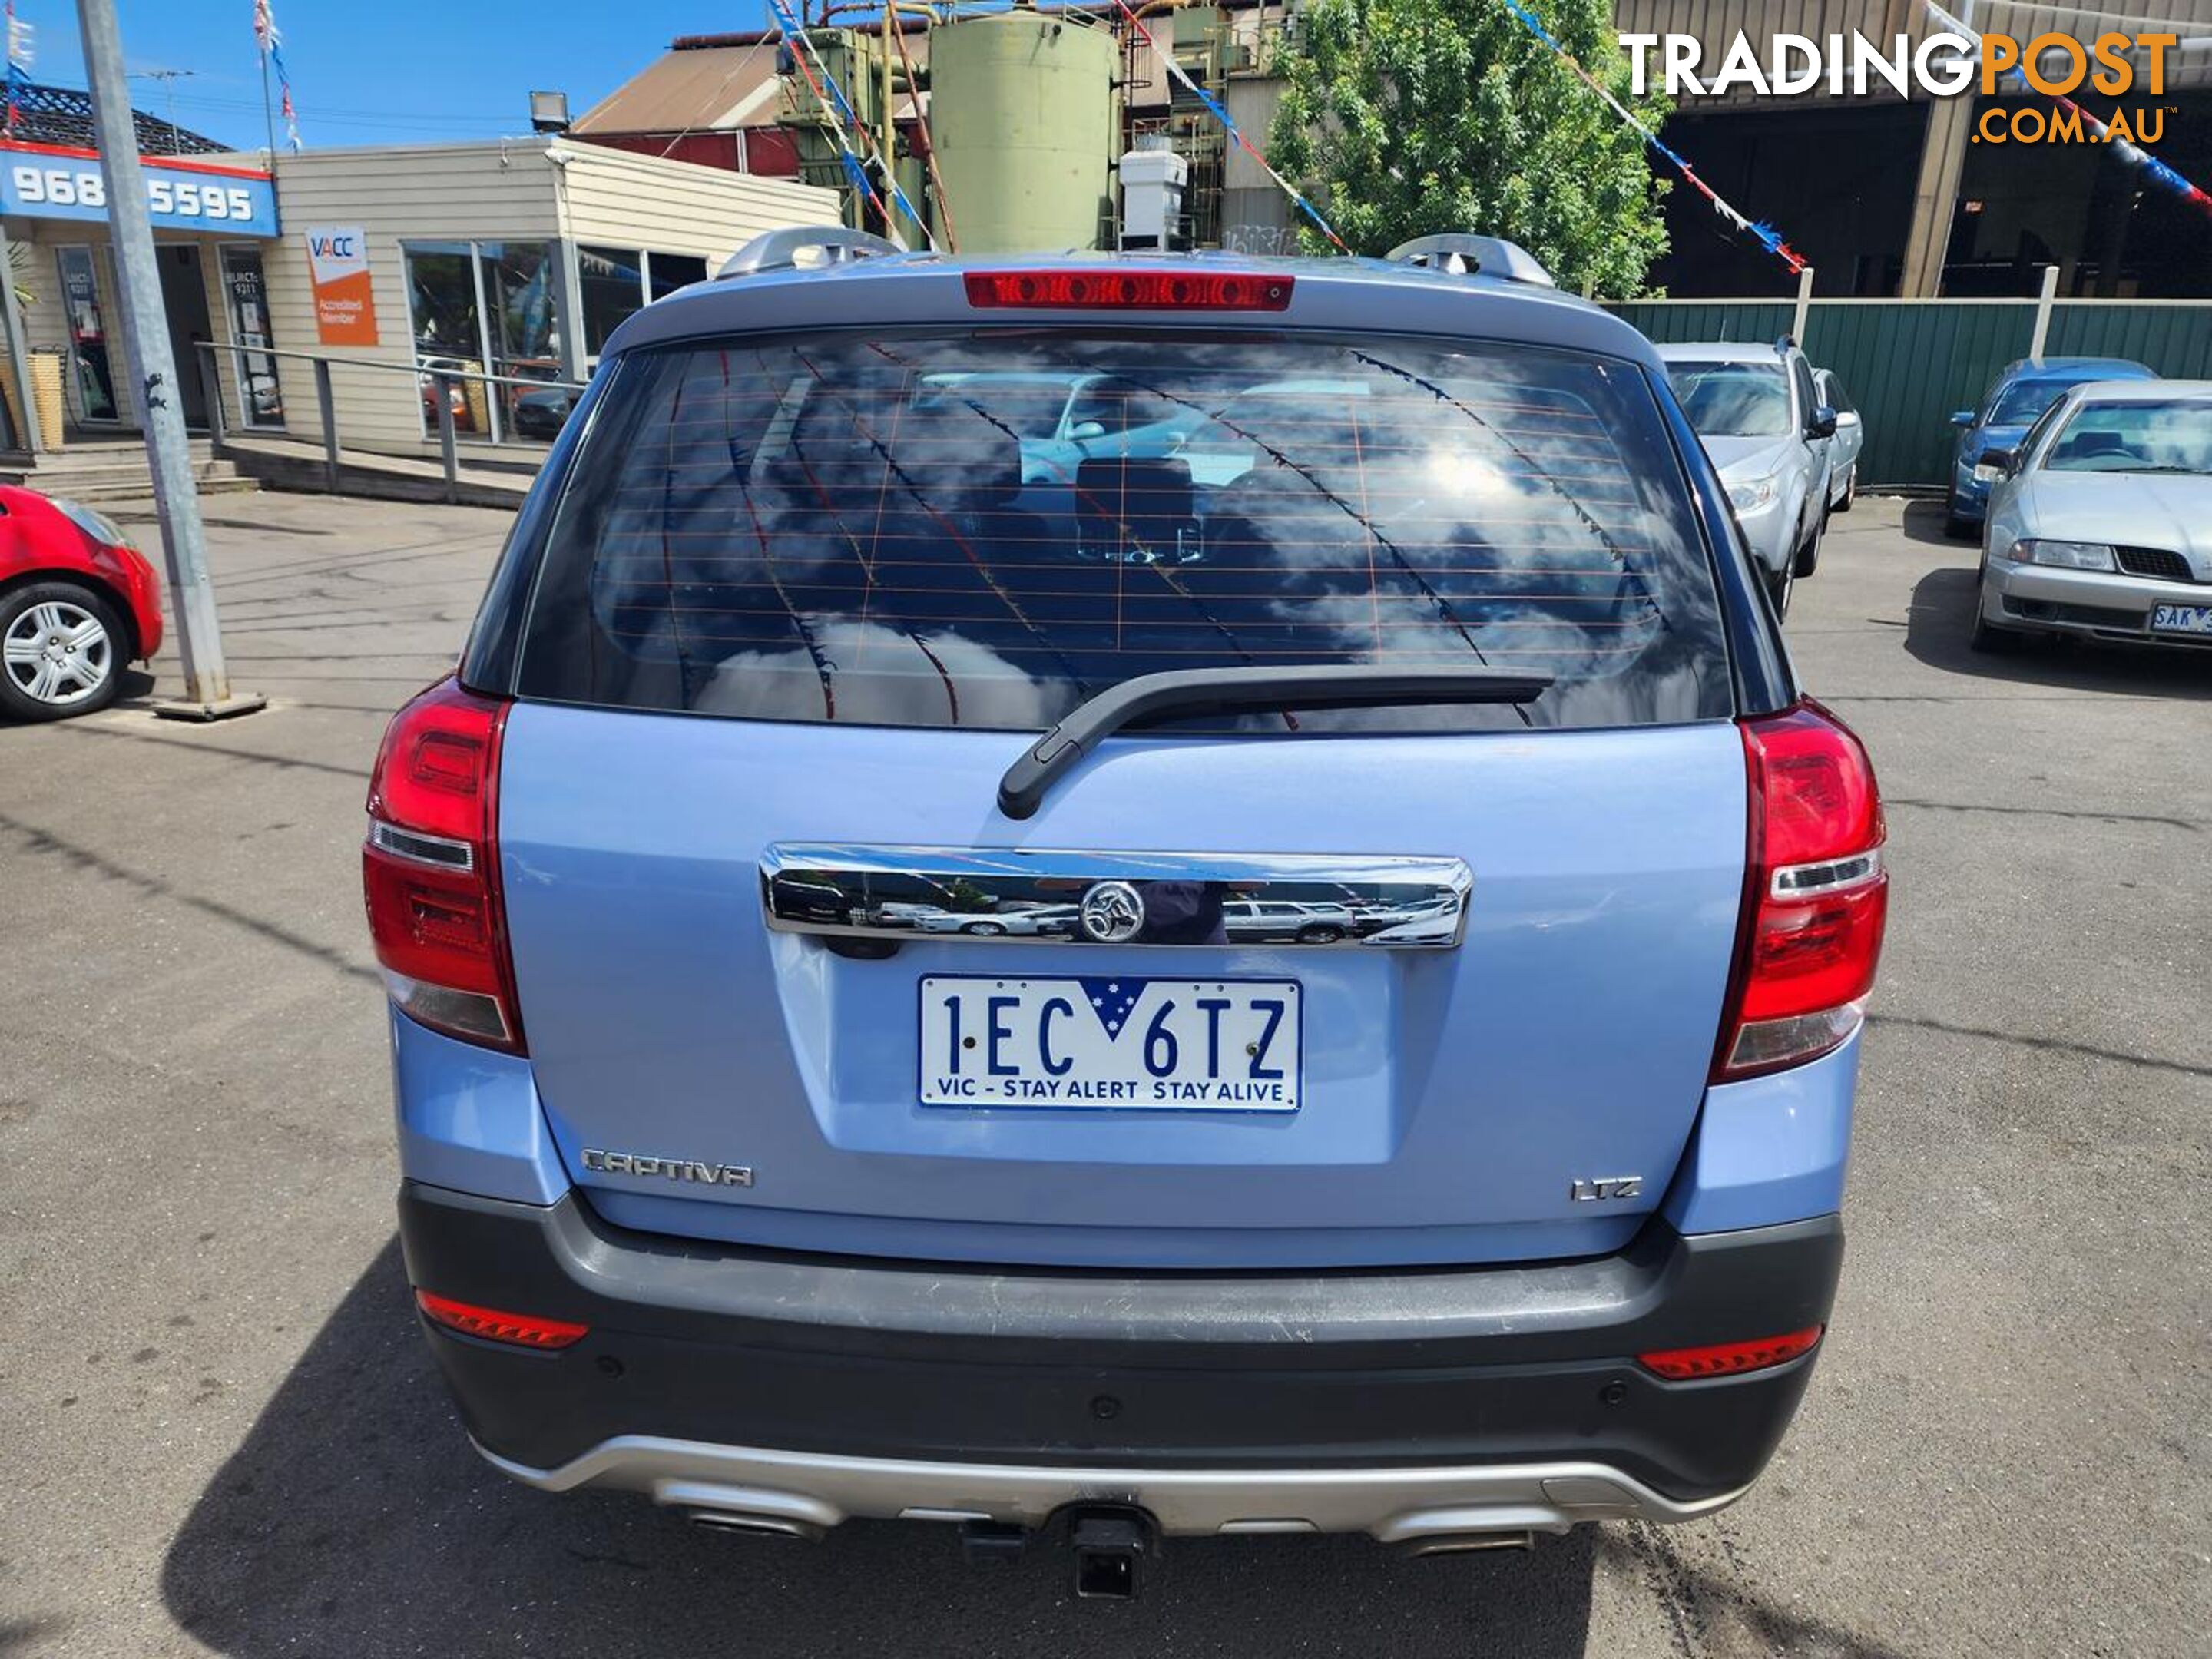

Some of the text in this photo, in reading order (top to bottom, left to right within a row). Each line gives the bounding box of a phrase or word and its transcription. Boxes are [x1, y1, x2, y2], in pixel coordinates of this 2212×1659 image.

[13, 166, 253, 221] 968 5595
[310, 237, 353, 257] VACC
[2154, 608, 2191, 626] SAK
[943, 996, 1285, 1079] 1EC 6TZ
[938, 1078, 976, 1097] VIC
[1003, 1079, 1061, 1098] STAY
[1066, 1081, 1139, 1099] ALERT
[1153, 1081, 1211, 1100] STAY
[1217, 1082, 1283, 1101] ALIVE
[580, 1148, 753, 1187] CAPTIVA
[1571, 1175, 1644, 1201] LTZ
